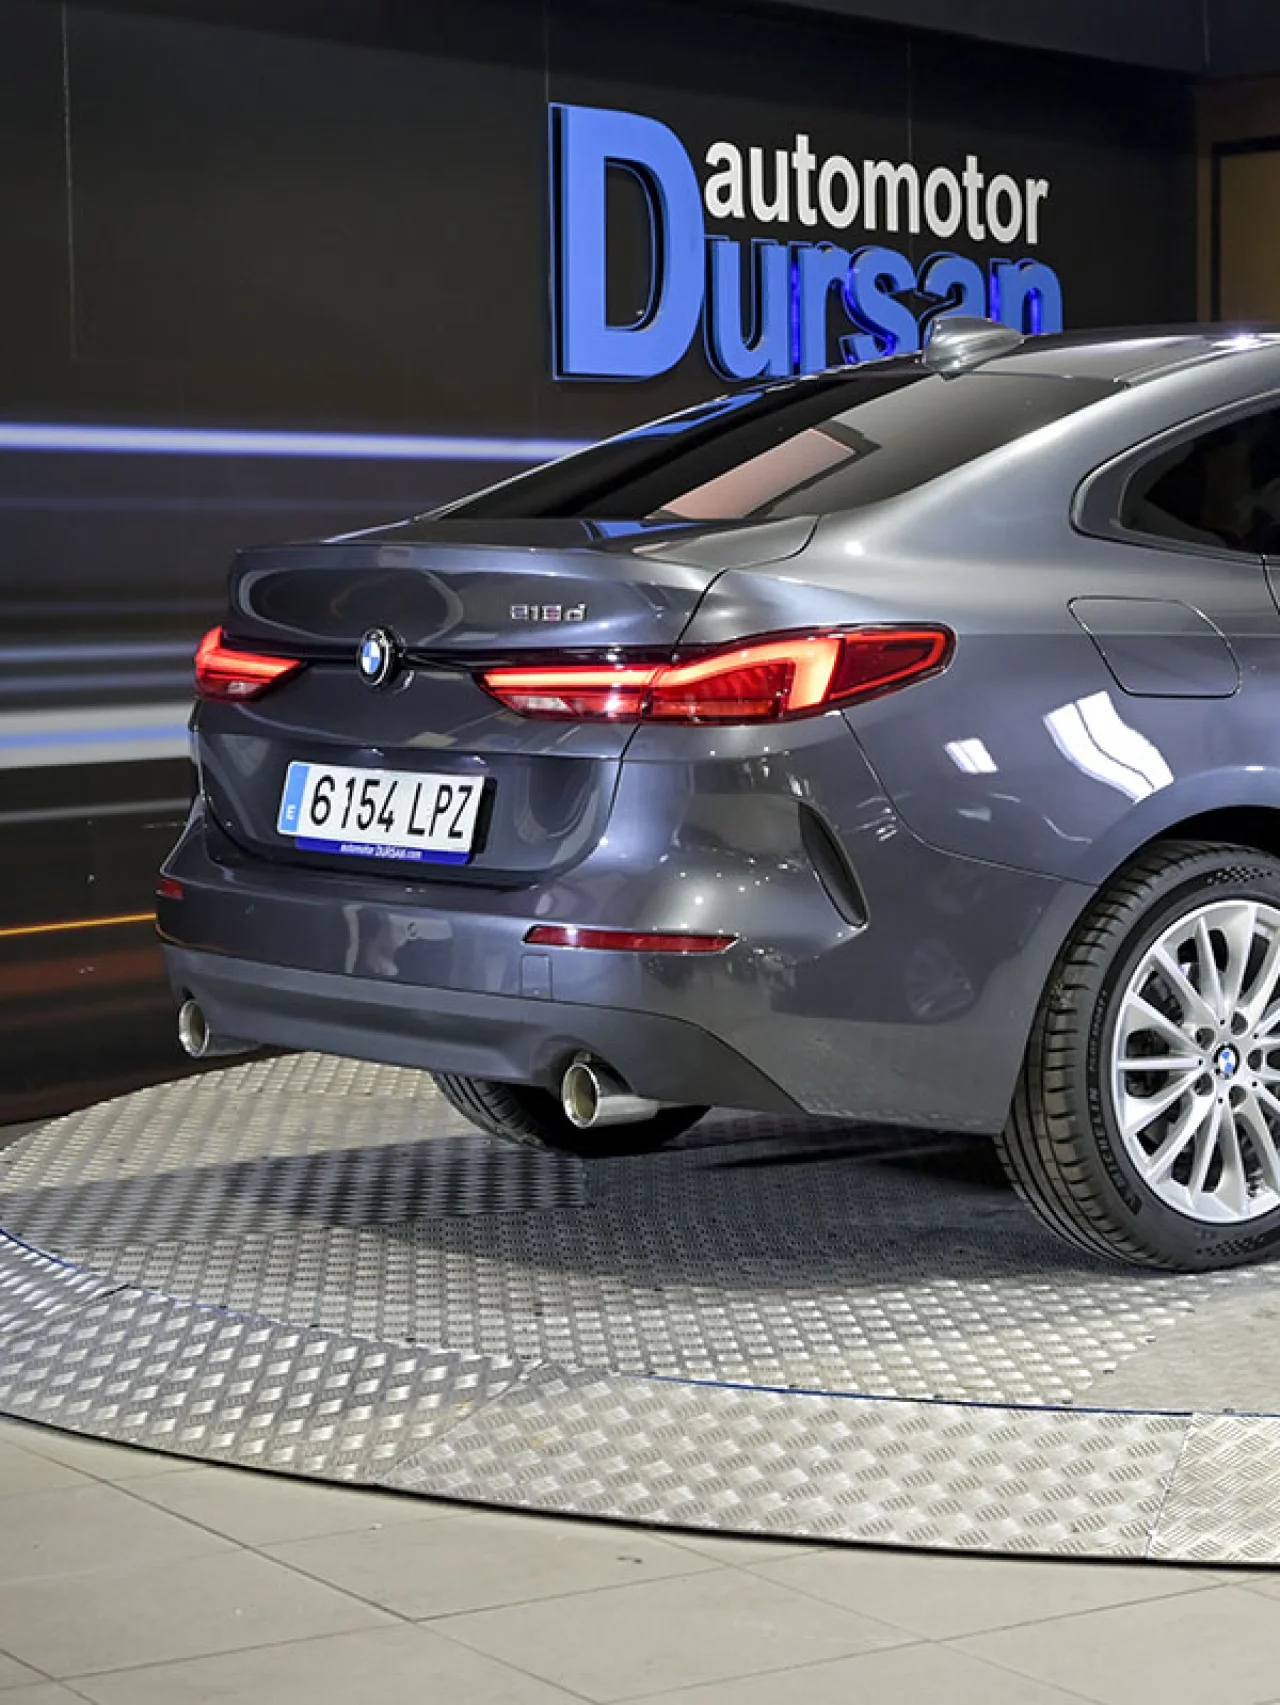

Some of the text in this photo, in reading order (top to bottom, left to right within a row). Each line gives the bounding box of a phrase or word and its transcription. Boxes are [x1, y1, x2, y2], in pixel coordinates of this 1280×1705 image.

[704, 133, 1050, 245] automotor
[548, 101, 1064, 382] Dursan
[285, 803, 297, 820] E
[310, 774, 474, 839] 6154 LPZ
